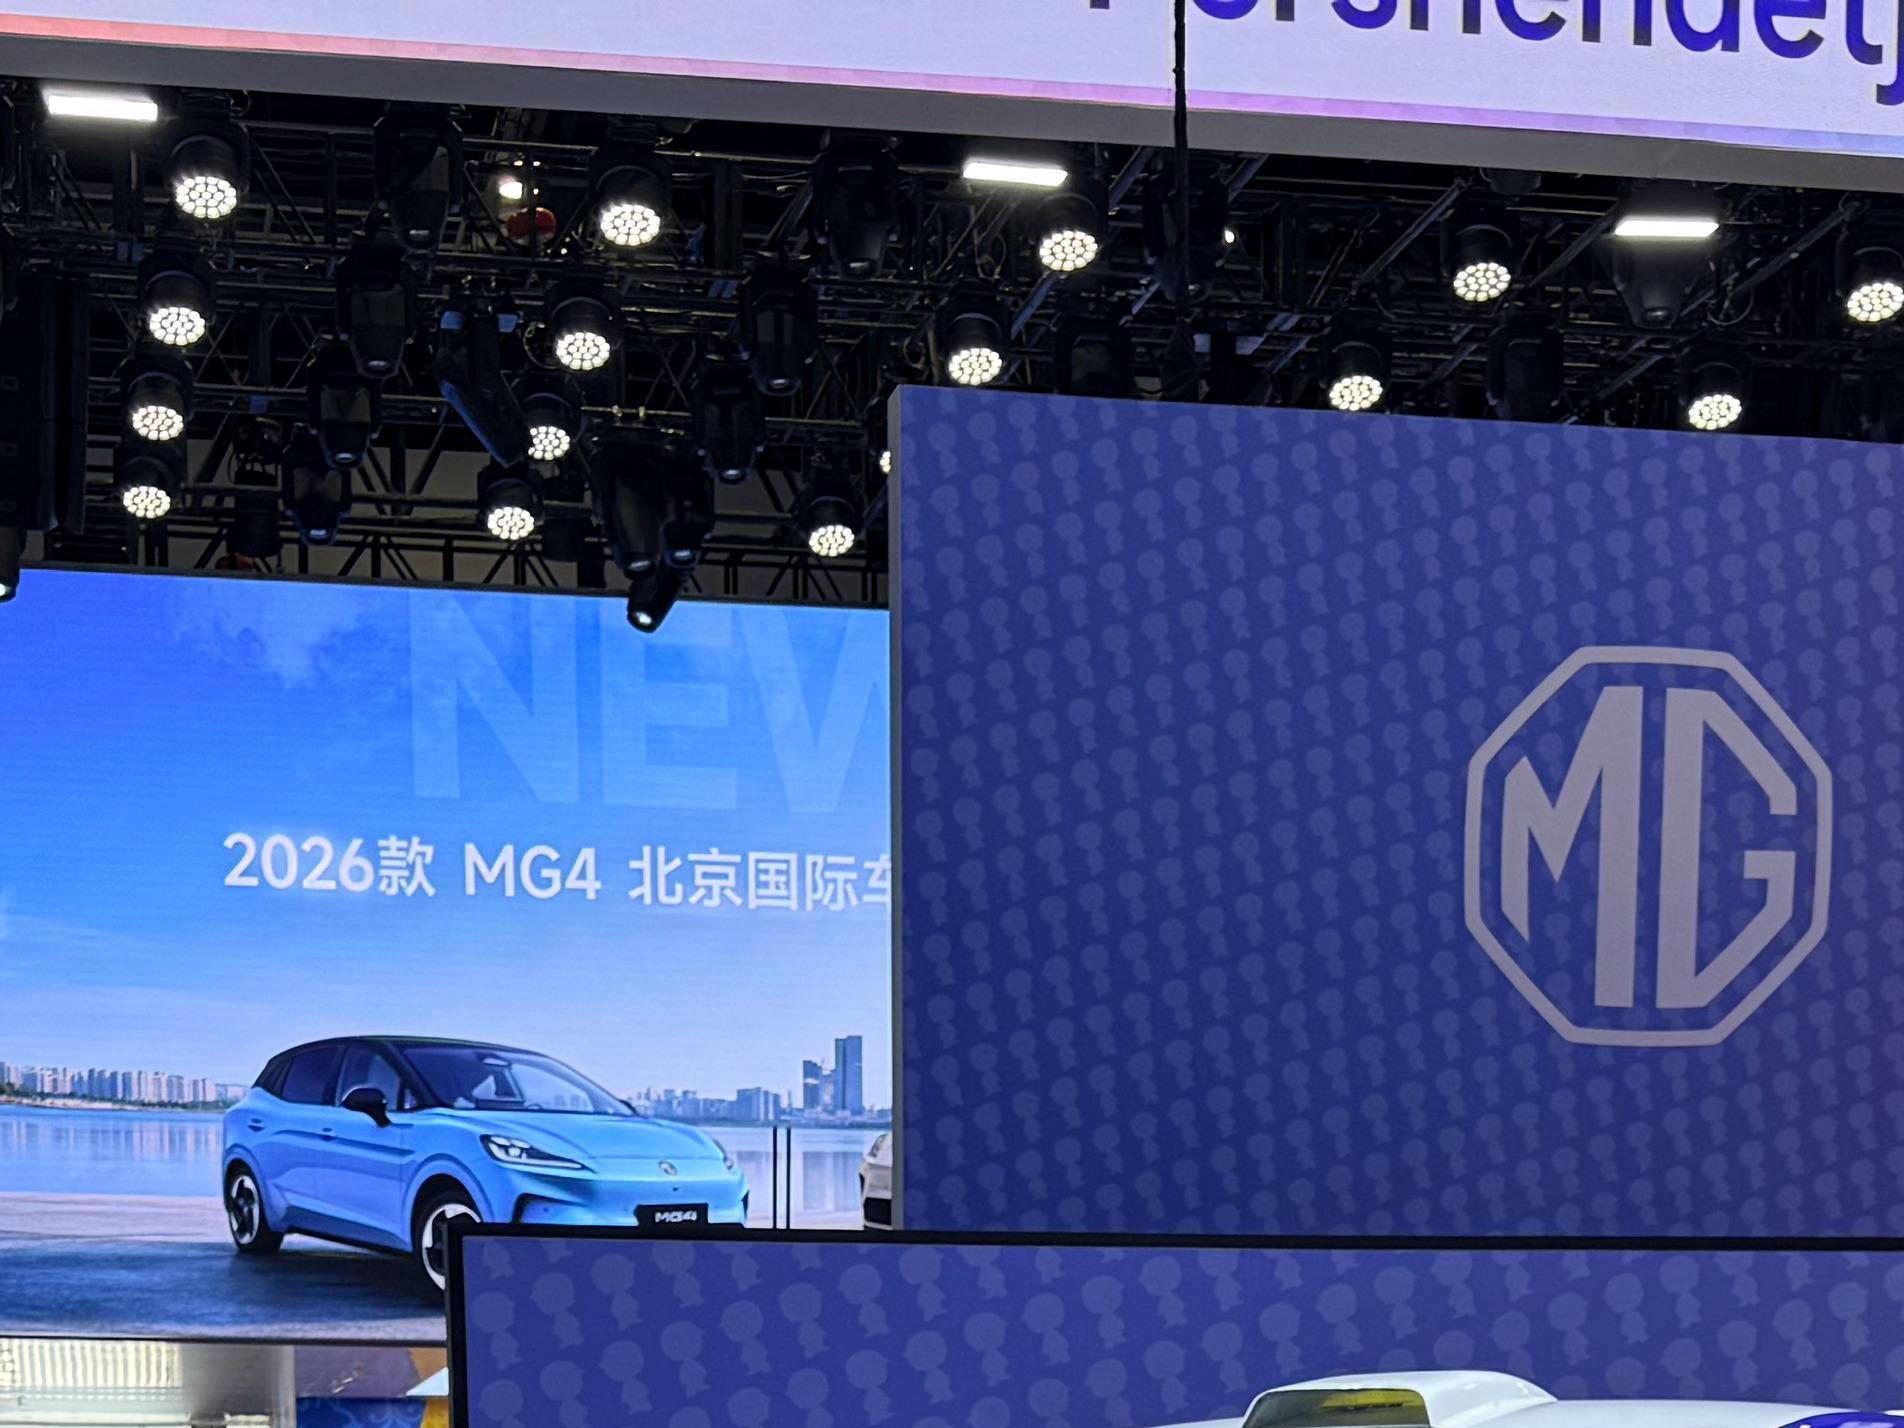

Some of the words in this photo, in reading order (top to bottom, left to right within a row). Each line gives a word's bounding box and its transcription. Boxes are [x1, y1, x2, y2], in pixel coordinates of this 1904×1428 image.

[223, 832, 436, 897] 2026款
[464, 842, 603, 900] MG4
[1501, 686, 1797, 1008] MG
